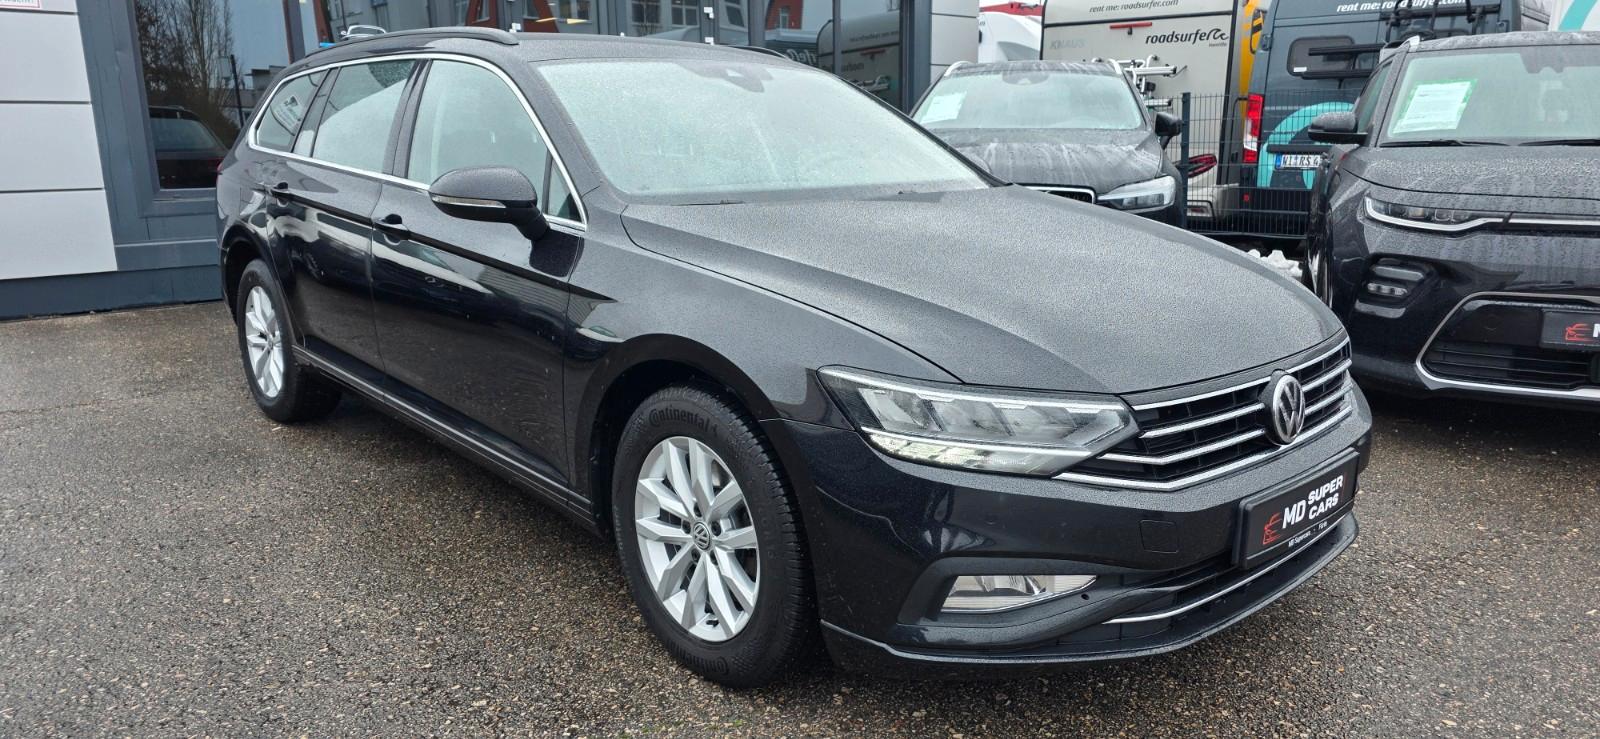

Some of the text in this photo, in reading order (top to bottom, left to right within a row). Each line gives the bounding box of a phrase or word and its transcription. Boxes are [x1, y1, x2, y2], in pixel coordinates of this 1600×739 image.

[1121, 0, 1179, 10] roadsurfer.com
[1337, 3, 1359, 12] rent
[1360, 2, 1380, 10] me:
[1145, 28, 1229, 45] roadsurfer
[649, 404, 710, 433] Continental
[1308, 475, 1344, 505] SUPER
[1282, 500, 1306, 529] MD
[1308, 493, 1339, 519] CARS
